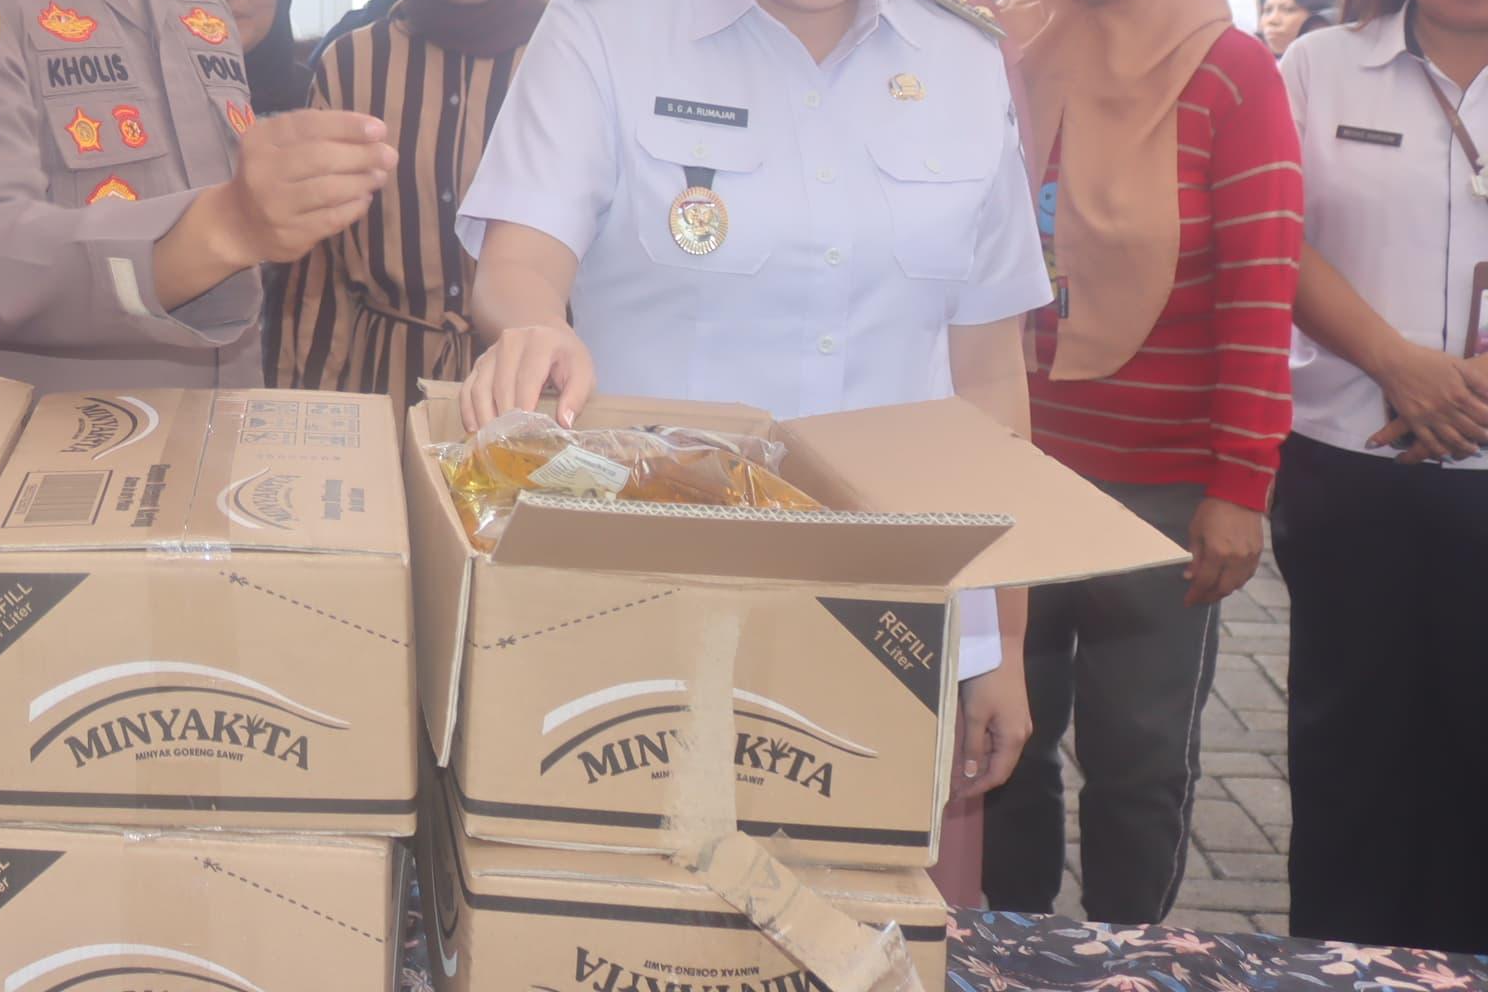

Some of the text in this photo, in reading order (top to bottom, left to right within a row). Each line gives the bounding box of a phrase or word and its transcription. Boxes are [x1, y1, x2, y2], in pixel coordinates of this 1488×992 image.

[47, 53, 129, 88] KHOLIS
[2, 602, 33, 631] Liter
[874, 629, 914, 670] 1 Liter
[879, 610, 934, 670] REFILL
[64, 708, 309, 771] MINYAKITA
[135, 747, 244, 762] MINYAK GORENG SAWIT
[576, 729, 833, 798] MINKITA
[736, 773, 765, 786] SAWIT
[644, 960, 760, 978] MINYAK GORENG SAWIT
